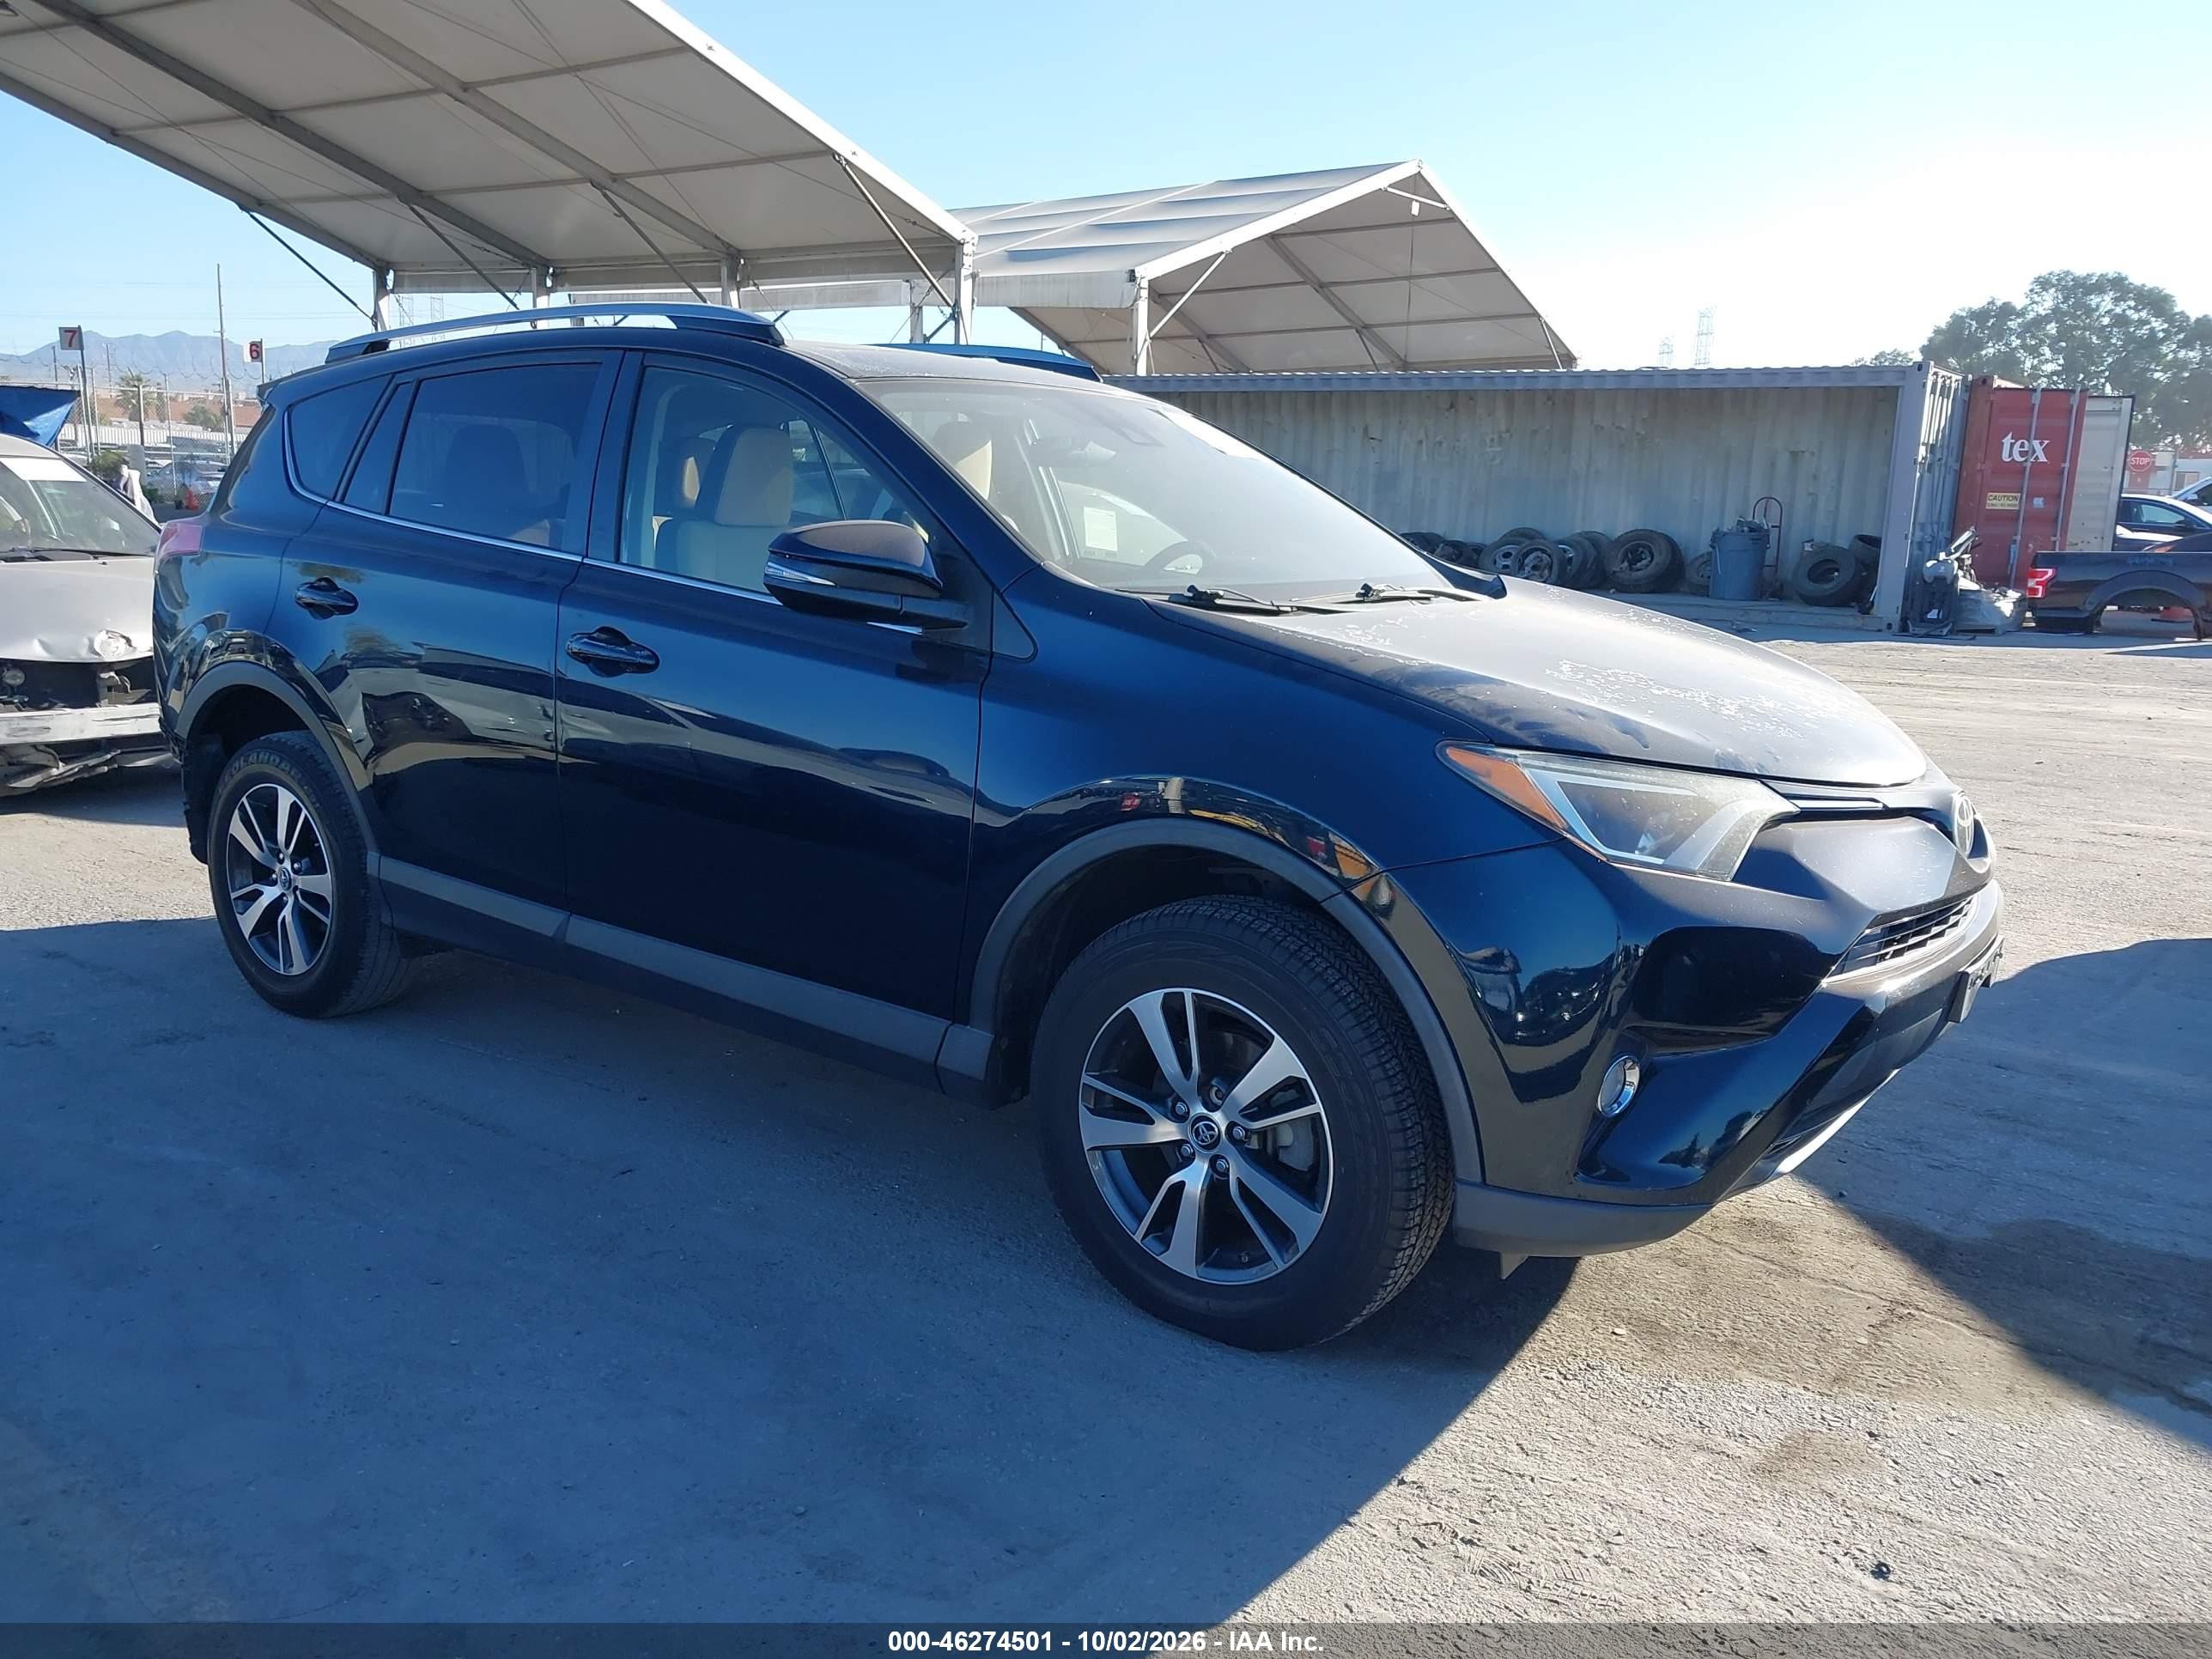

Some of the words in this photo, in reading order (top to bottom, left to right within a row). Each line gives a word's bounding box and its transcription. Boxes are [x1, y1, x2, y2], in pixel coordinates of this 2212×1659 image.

[64, 330, 78, 348] 7
[249, 343, 260, 360] 6
[2002, 431, 2051, 462] tex
[2130, 457, 2150, 465] STOP
